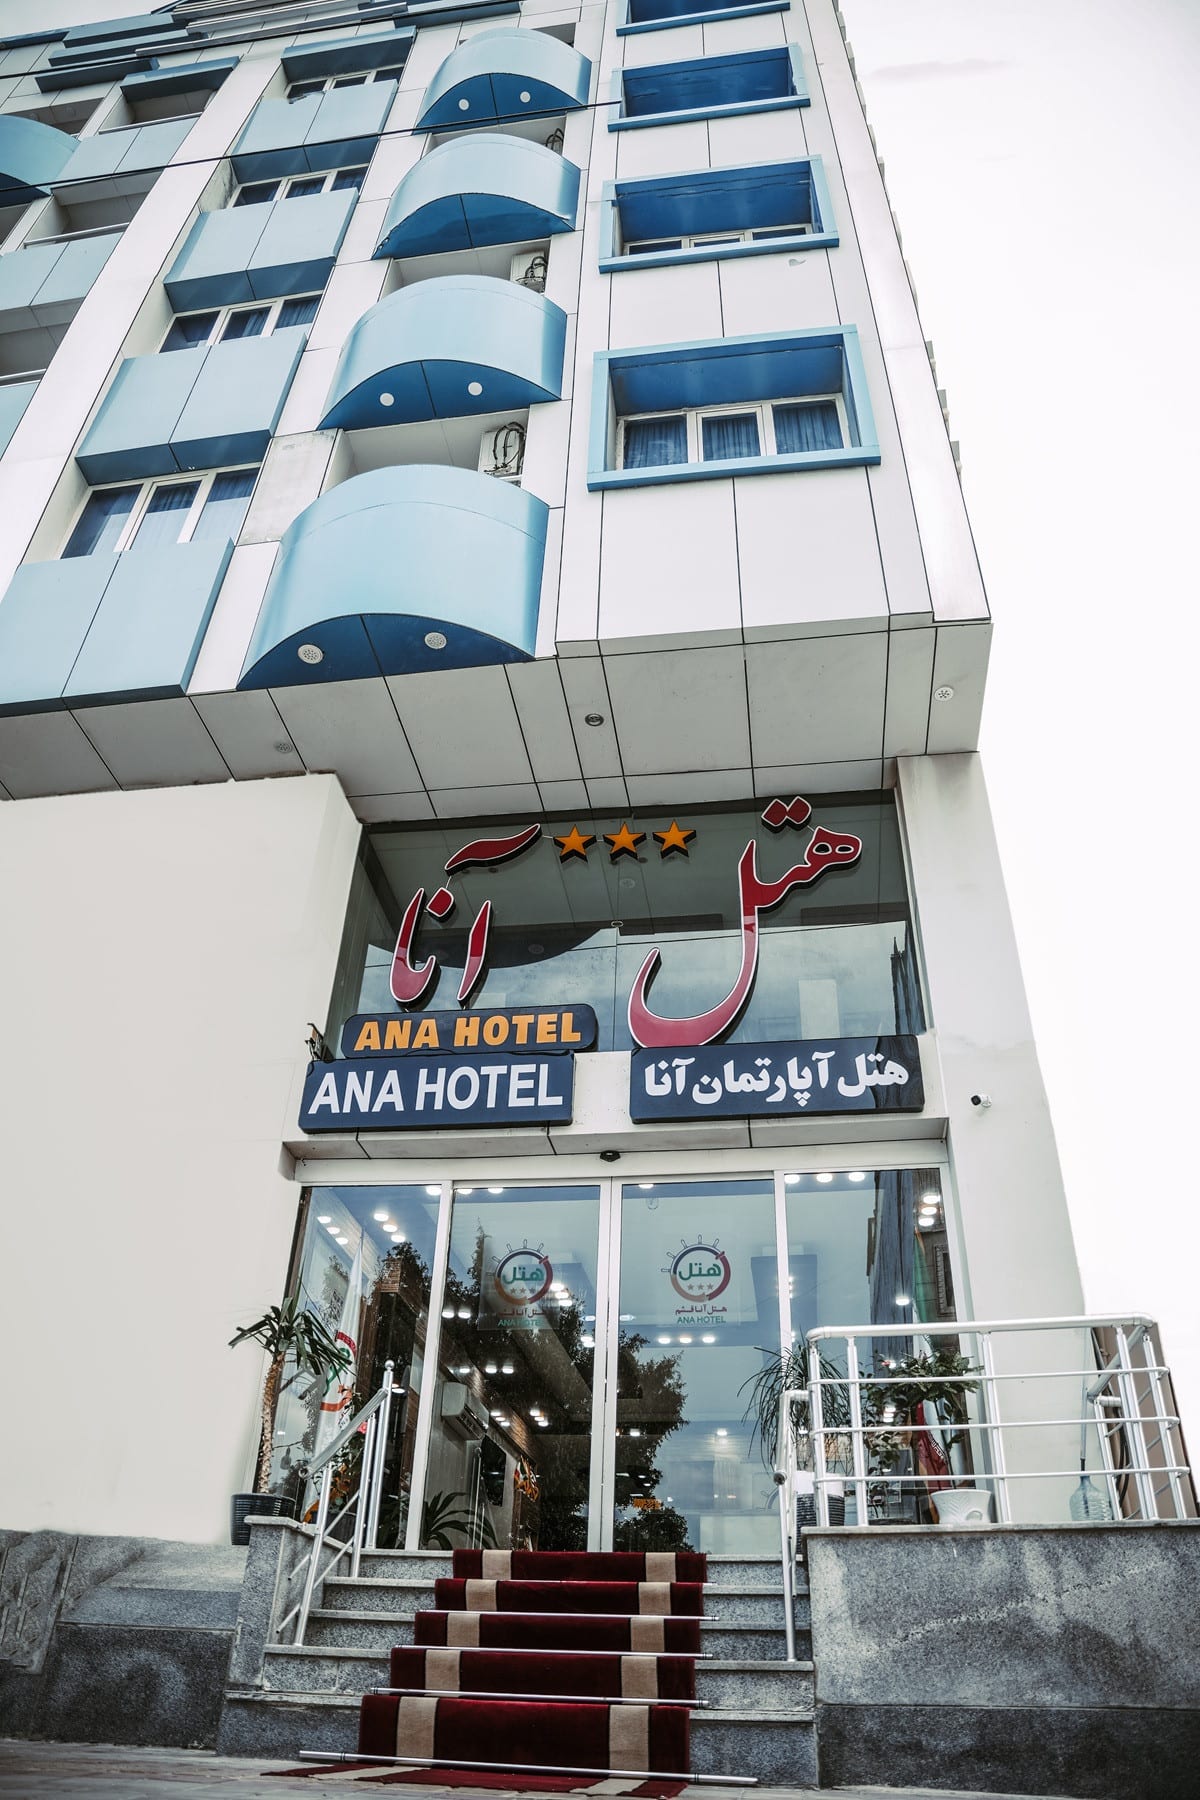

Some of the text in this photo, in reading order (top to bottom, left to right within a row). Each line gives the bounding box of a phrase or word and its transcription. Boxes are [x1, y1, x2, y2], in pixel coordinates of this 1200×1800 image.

[389, 795, 863, 1047] هتل آنا
[353, 1012, 582, 1051] ANA HOTEL
[308, 1063, 563, 1114] ANA HOTEL
[644, 1050, 909, 1107] هتل آپارتمان آنا
[502, 1266, 545, 1284] هتل
[678, 1262, 721, 1281] هتل
[677, 1316, 726, 1324] ANA HOTEL
[707, 1305, 727, 1315] هتل
